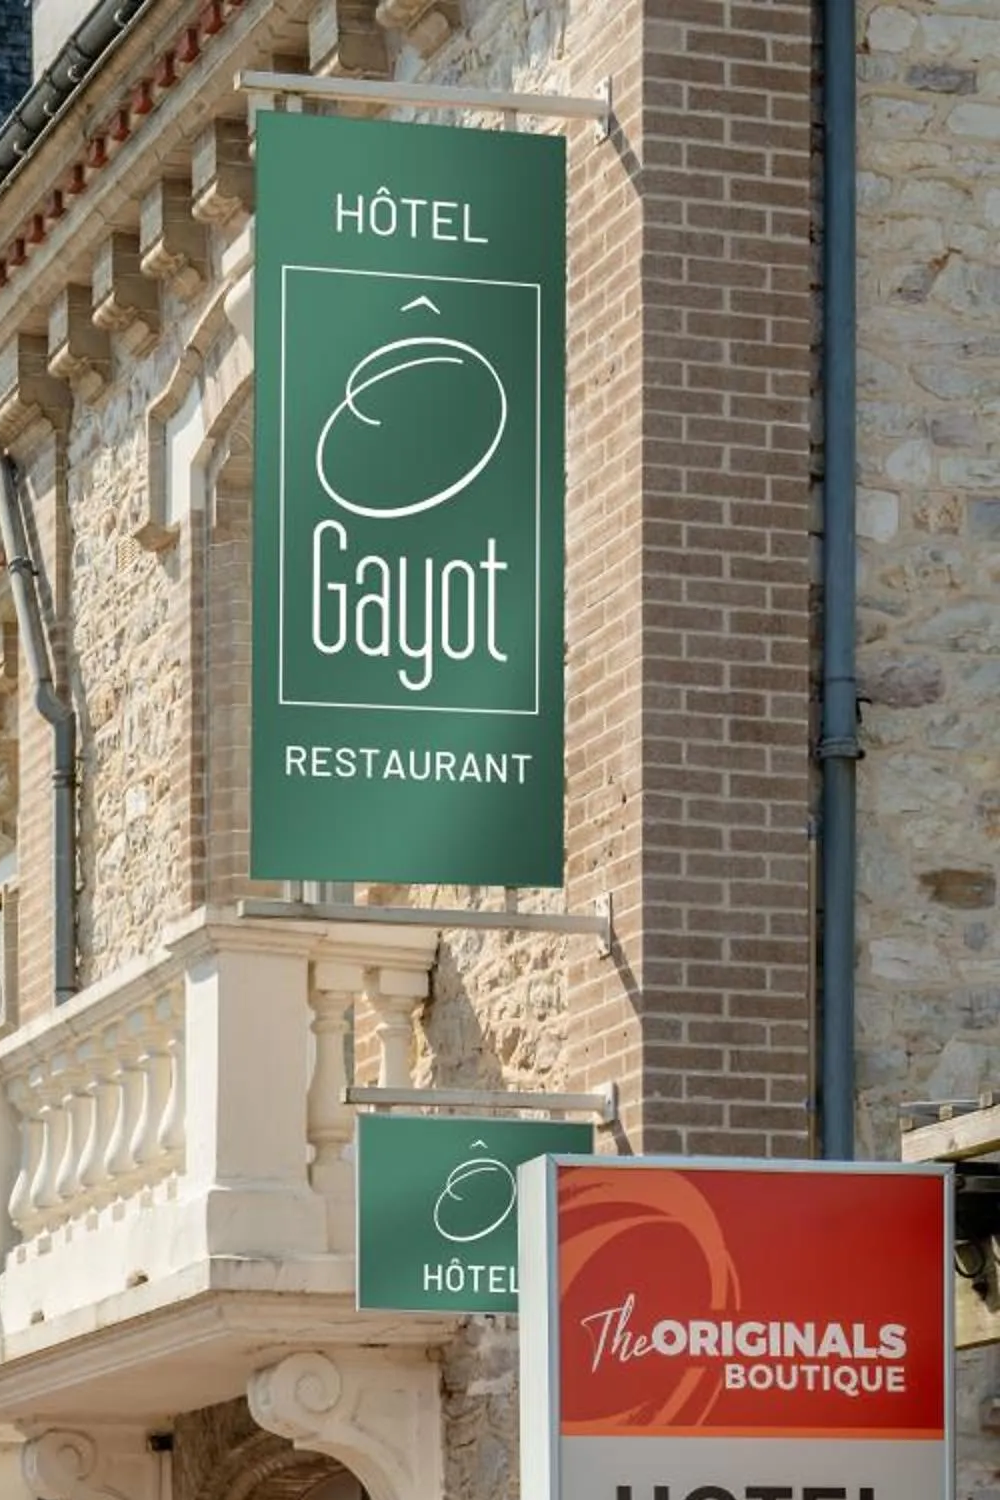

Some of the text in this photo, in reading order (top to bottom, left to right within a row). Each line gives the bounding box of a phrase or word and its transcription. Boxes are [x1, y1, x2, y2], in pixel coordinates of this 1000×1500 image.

[335, 185, 489, 244] HÔTEL
[311, 518, 509, 692] Gayot
[284, 744, 533, 785] RESTAURANT
[651, 1319, 908, 1361] ORIGINALS
[724, 1364, 907, 1396] BOUTIQUE
